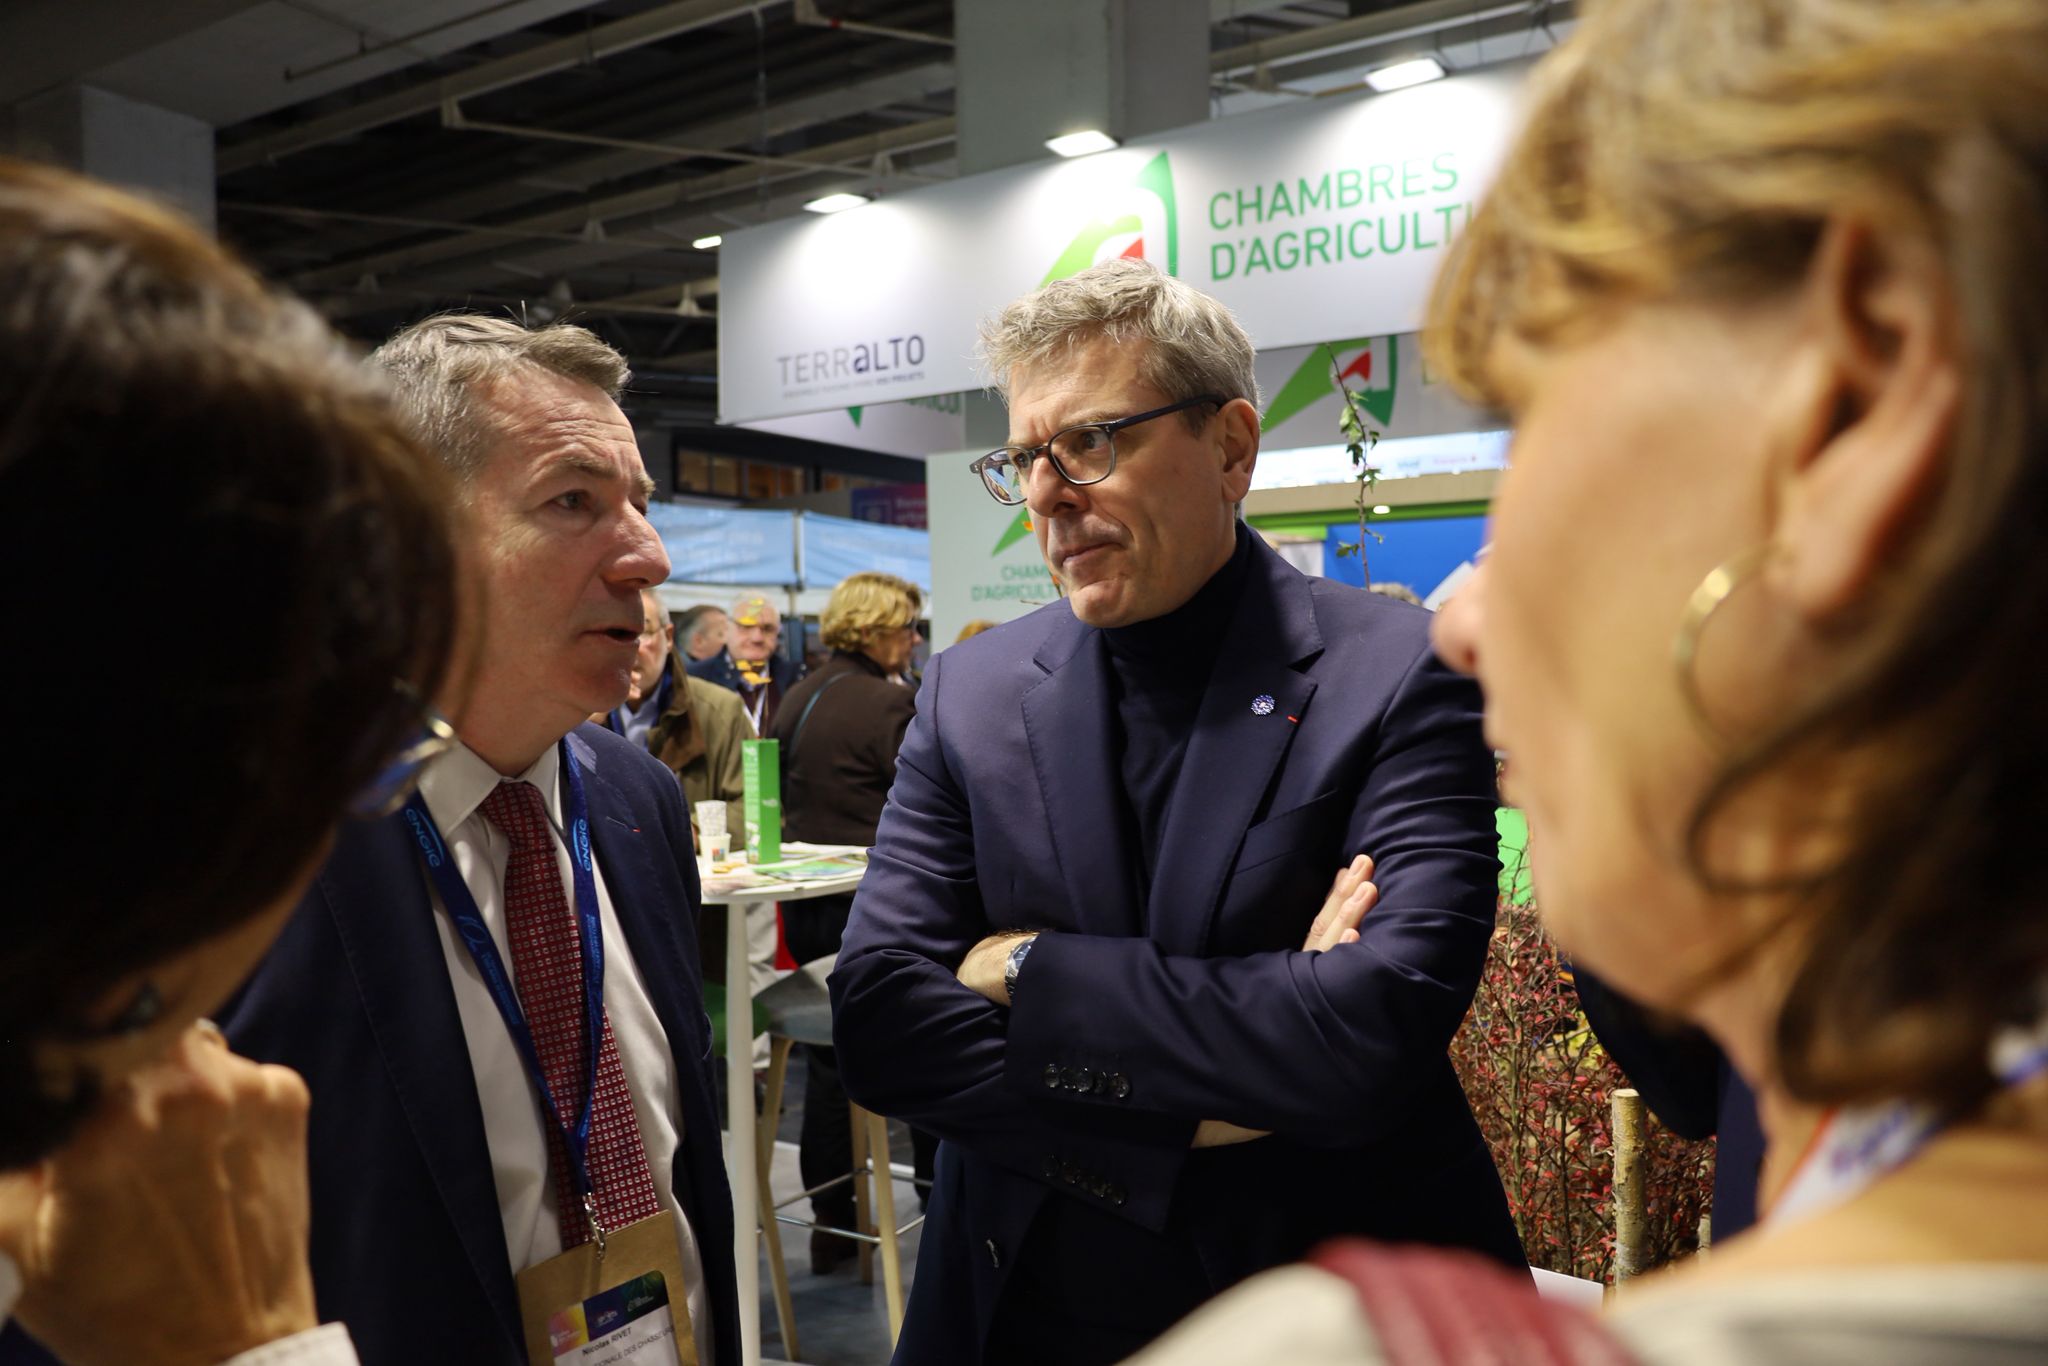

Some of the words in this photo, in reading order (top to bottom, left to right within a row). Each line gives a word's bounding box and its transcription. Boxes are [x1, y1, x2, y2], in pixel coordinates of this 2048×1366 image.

[1208, 152, 1459, 232] CHAMBRES
[581, 1339, 610, 1356] Nicolas
[610, 1326, 632, 1343] RIVET
